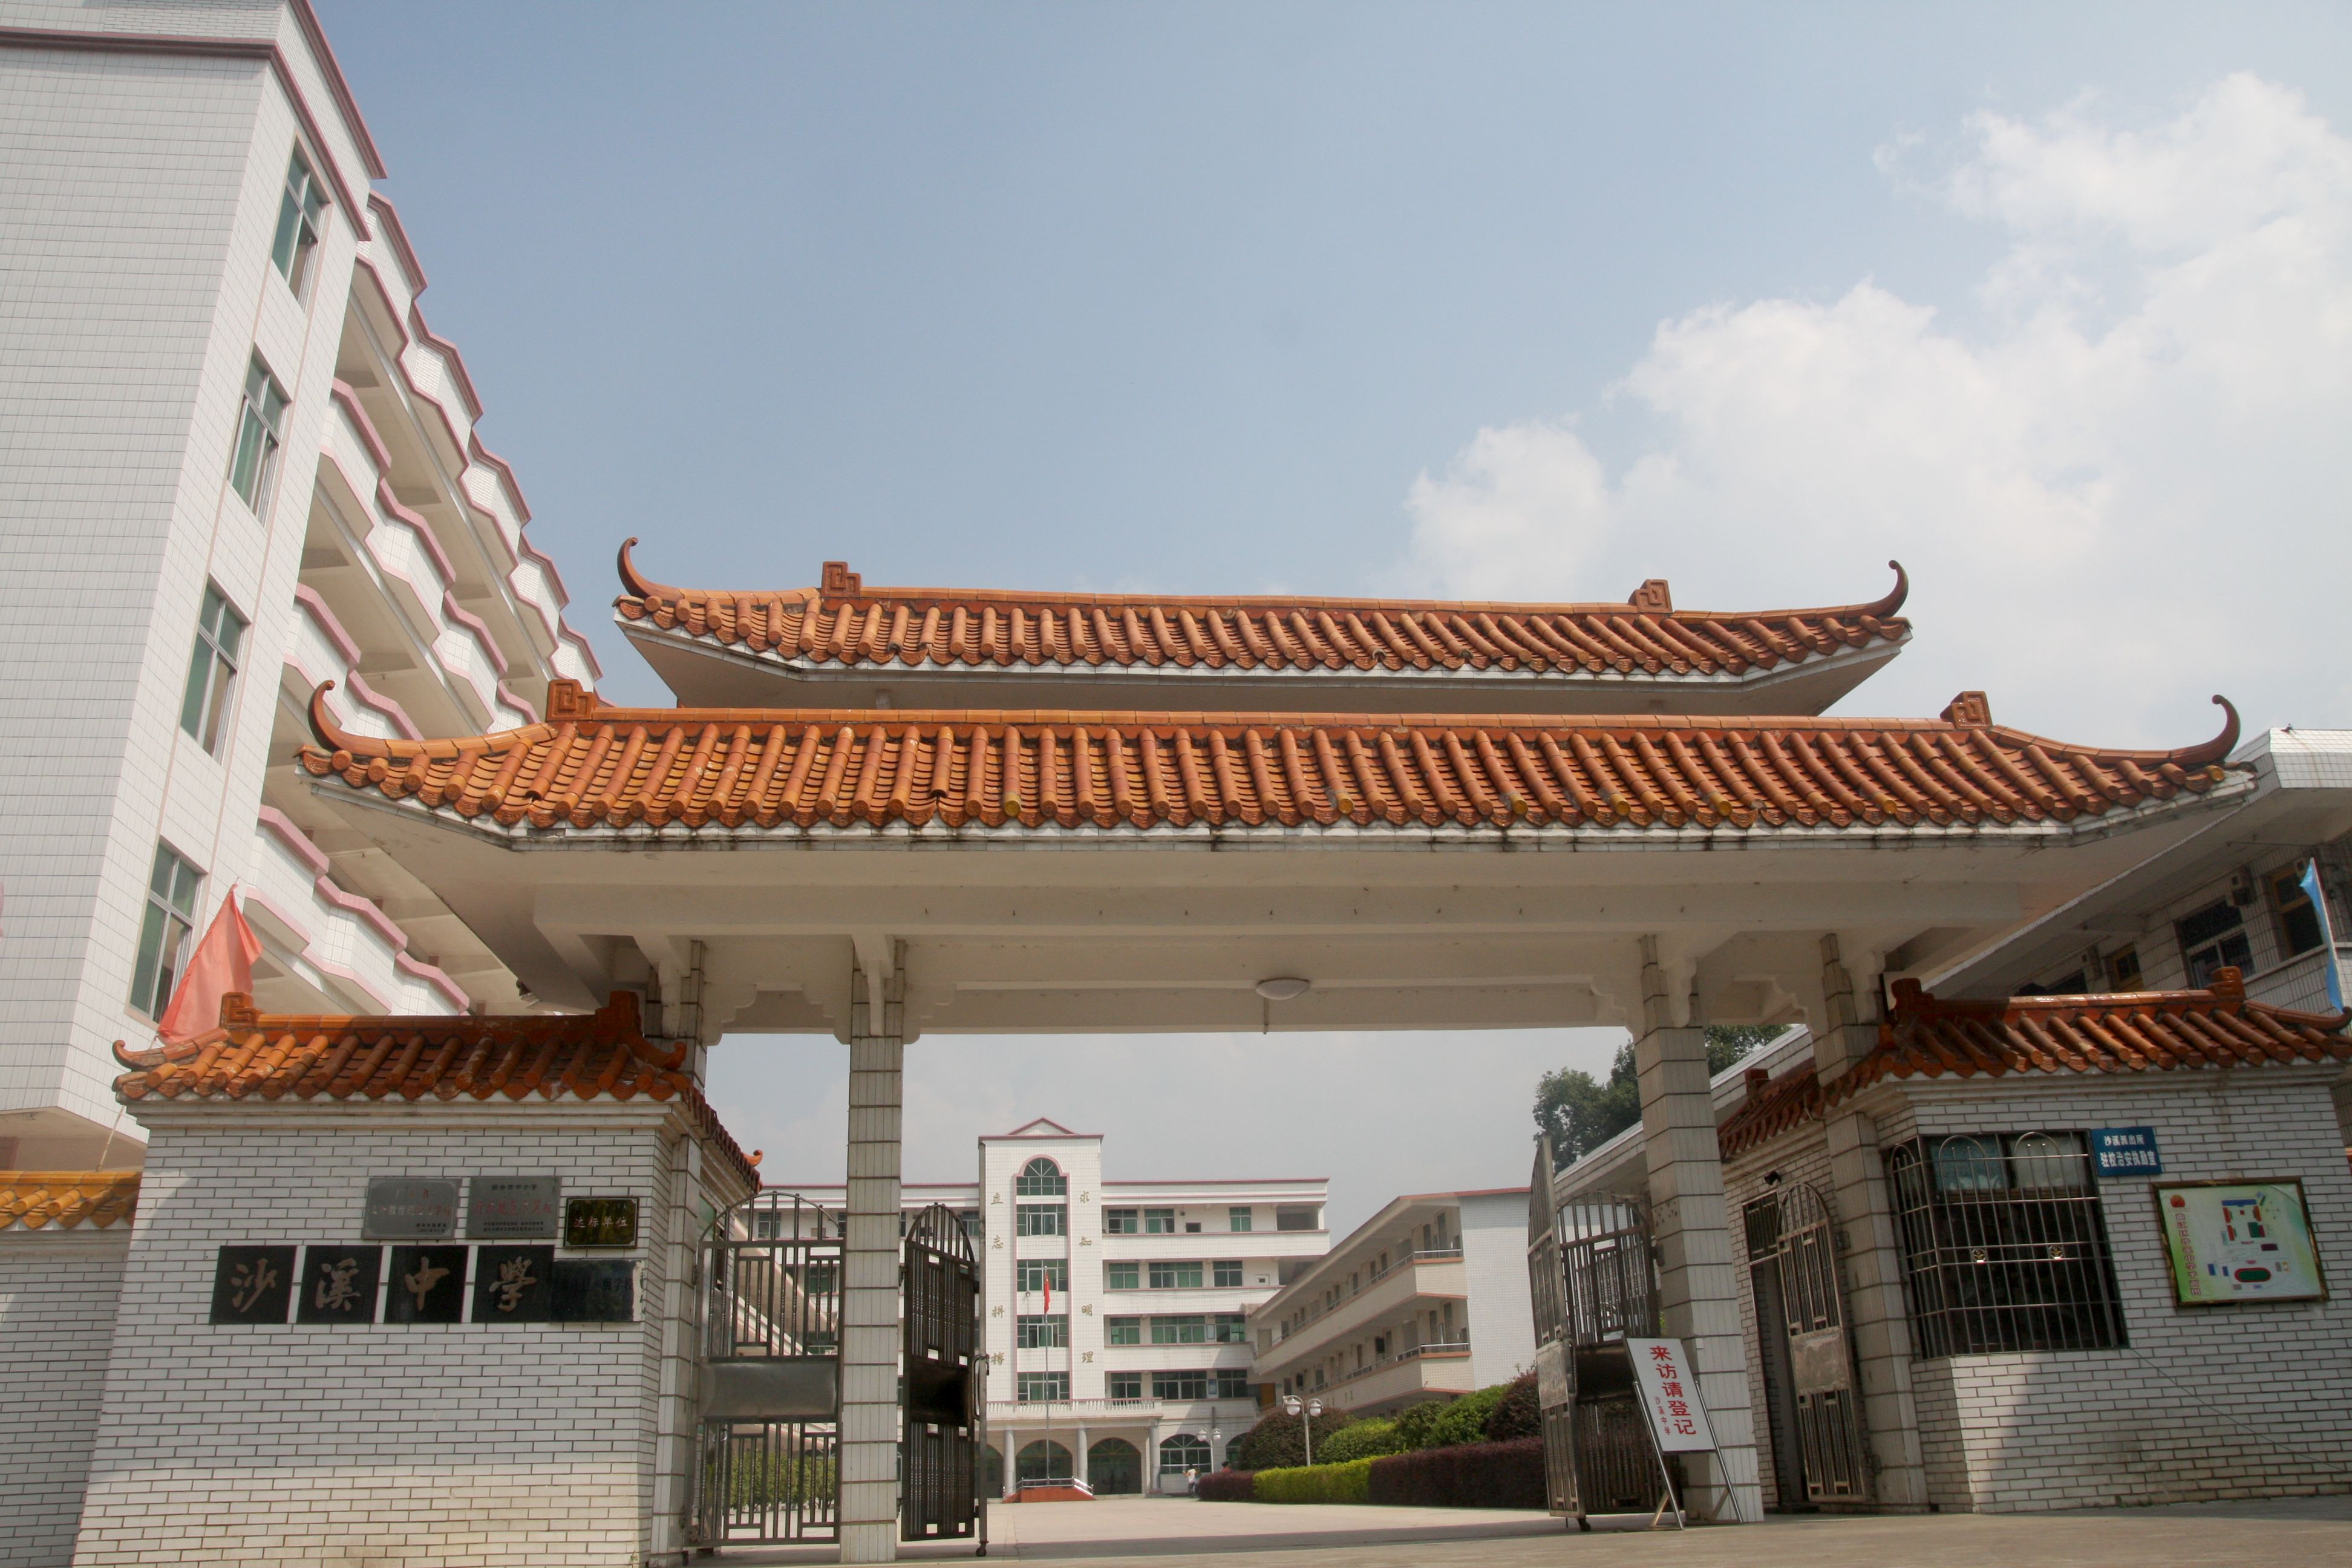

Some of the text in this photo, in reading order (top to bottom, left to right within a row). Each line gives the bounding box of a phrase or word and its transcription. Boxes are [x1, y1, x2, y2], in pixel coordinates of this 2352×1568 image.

[2103, 1134, 2145, 1146] 沙溪派出所
[2100, 1150, 2157, 1168] 驻校治安执勤室
[573, 1215, 627, 1229] 达标单位
[1079, 1190, 1094, 1364] 求知明理
[1650, 1345, 1696, 1435] 来访请登记
